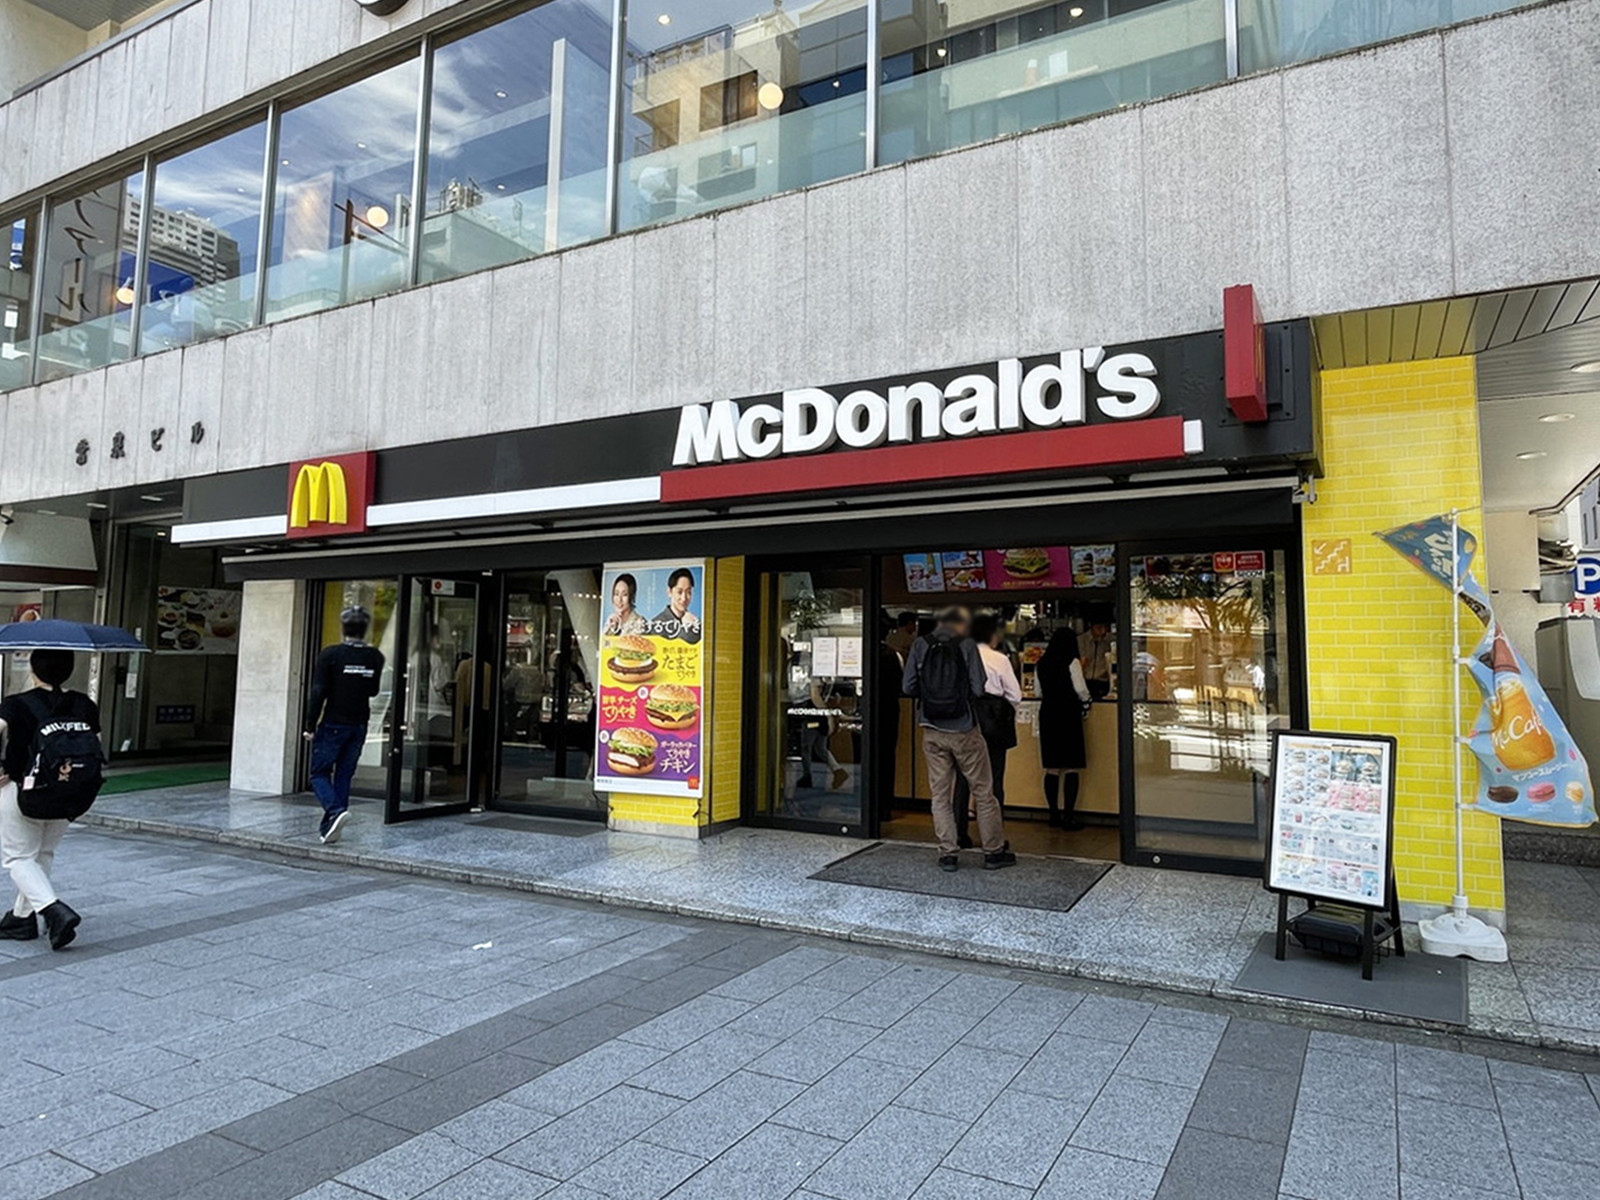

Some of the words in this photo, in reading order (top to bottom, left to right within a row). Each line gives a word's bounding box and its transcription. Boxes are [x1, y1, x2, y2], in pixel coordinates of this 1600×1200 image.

[672, 345, 1160, 467] McDonald's
[1577, 563, 1600, 590] P
[662, 654, 698, 670] たまご
[602, 705, 637, 723] てりやき
[659, 758, 697, 774] チキン
